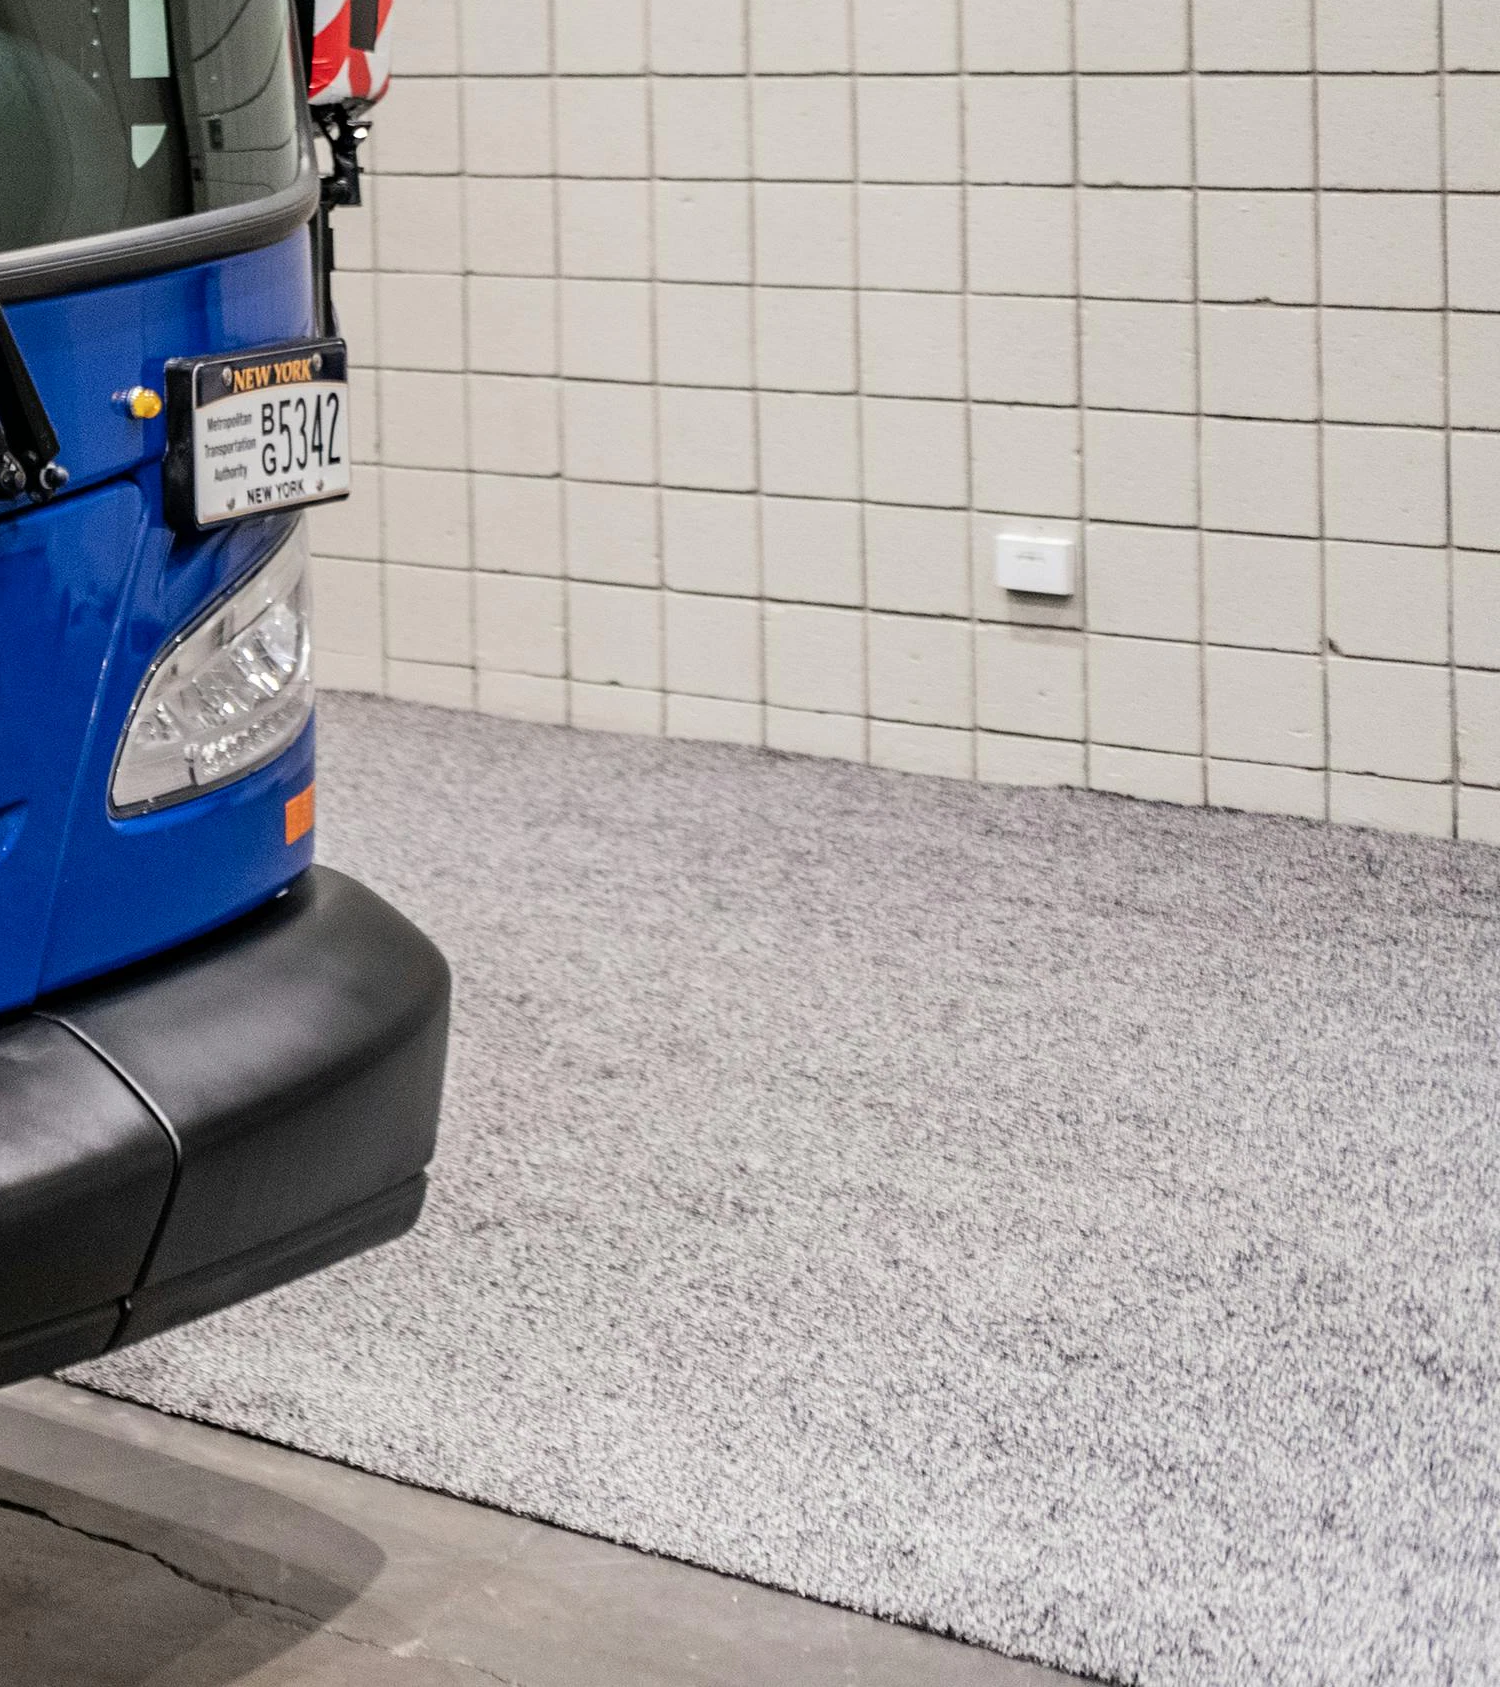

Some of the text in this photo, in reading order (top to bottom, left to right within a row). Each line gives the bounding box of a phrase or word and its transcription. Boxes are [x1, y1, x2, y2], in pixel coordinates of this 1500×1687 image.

[233, 358, 313, 394] NEW YORK
[206, 413, 253, 432] Metropolitan
[204, 438, 257, 459] Transportation
[214, 464, 248, 482] Authority
[246, 478, 308, 506] NEW YORK
